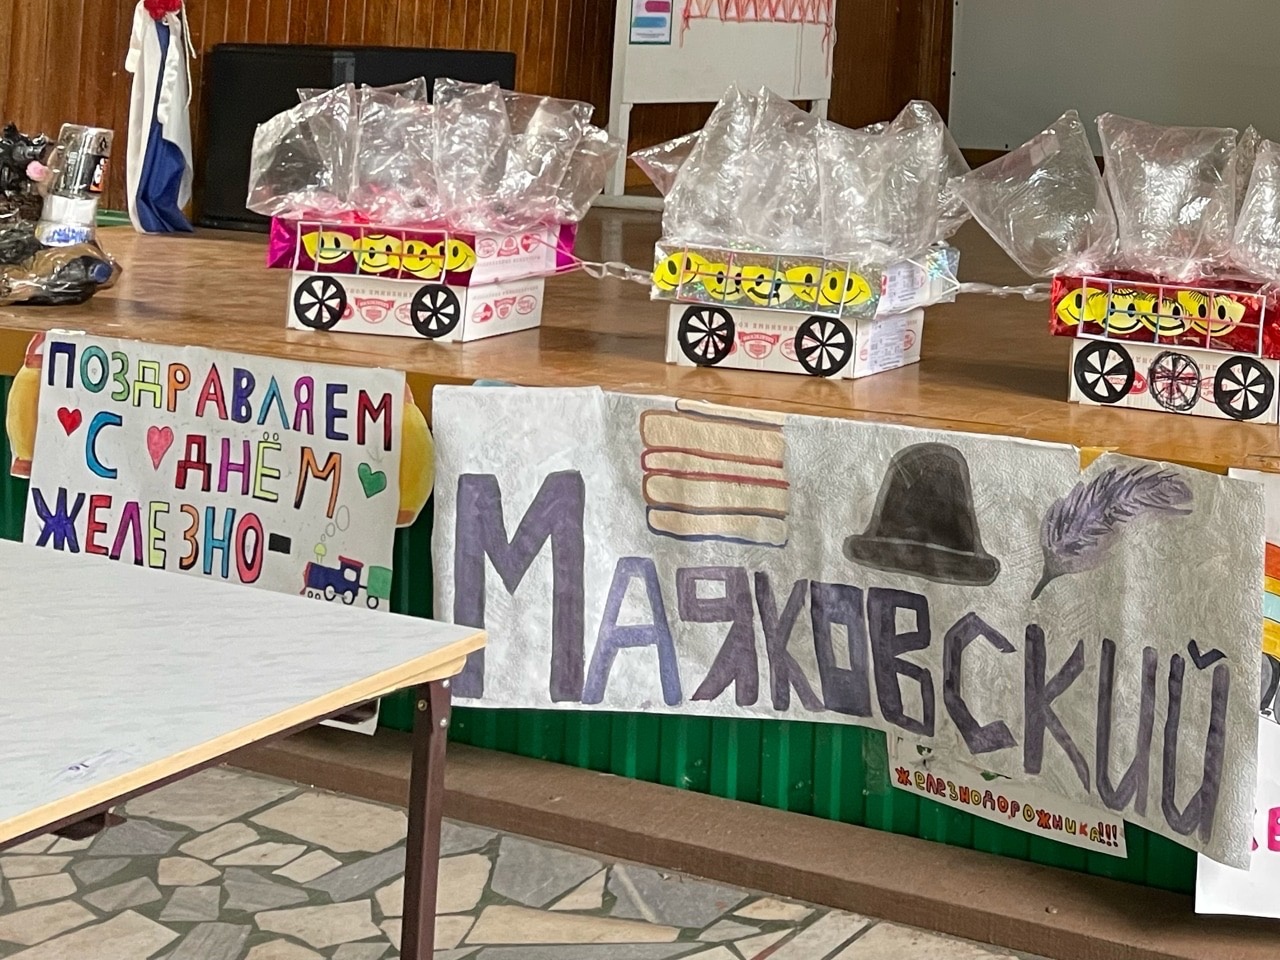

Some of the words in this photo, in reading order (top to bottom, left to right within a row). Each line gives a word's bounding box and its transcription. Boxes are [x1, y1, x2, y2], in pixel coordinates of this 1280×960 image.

[48, 341, 392, 451] ПОЗДРАВЛЯЕМ
[86, 410, 123, 479] С
[175, 431, 342, 519] ДНЁМ
[31, 486, 292, 584] ЖЕЛЕЗНО-
